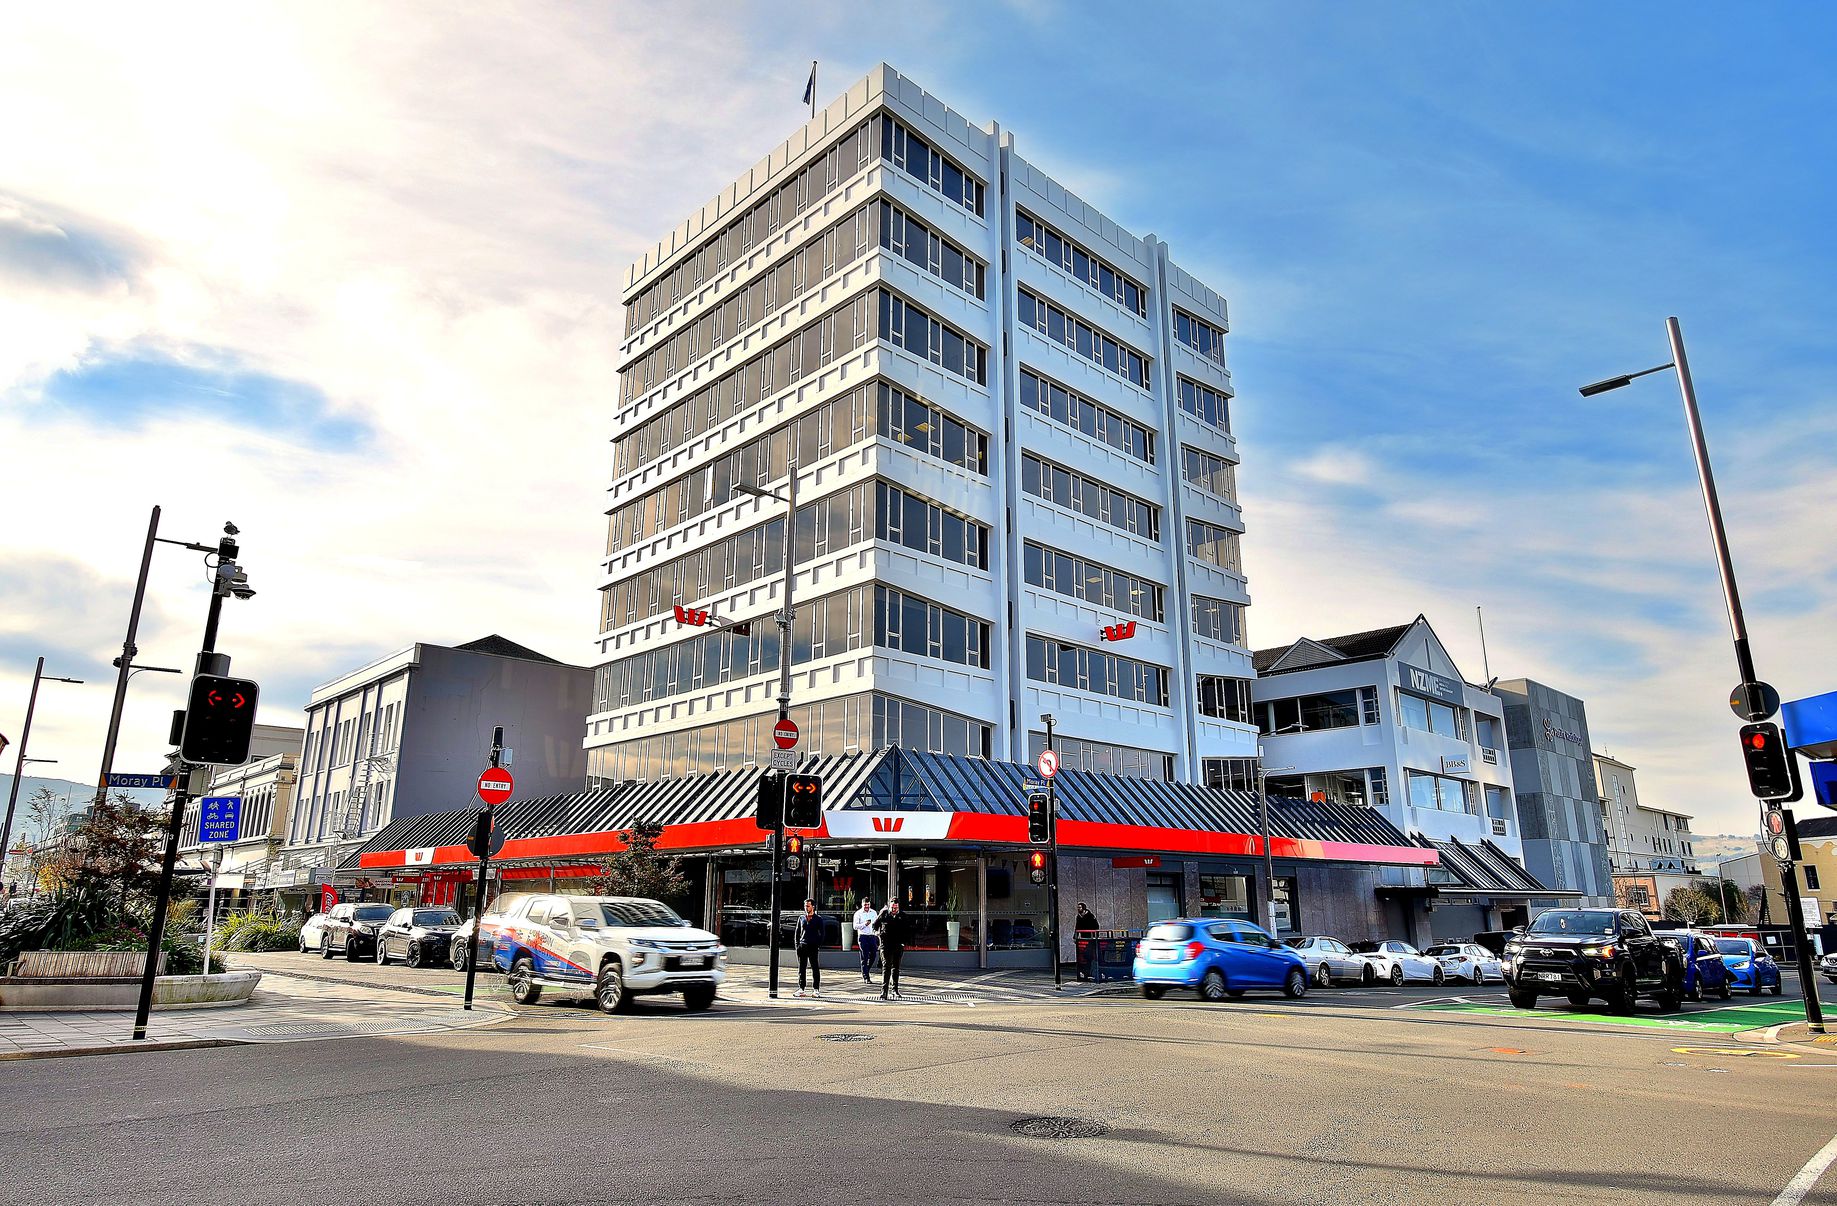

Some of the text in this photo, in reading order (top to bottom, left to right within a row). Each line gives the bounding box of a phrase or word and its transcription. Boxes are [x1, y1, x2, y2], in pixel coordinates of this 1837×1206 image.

[773, 752, 794, 760] EXCEPT
[772, 760, 794, 768] CYCLES
[108, 774, 164, 788] Moray Pl
[204, 821, 235, 830] SHARED
[208, 829, 229, 839] ZONE
